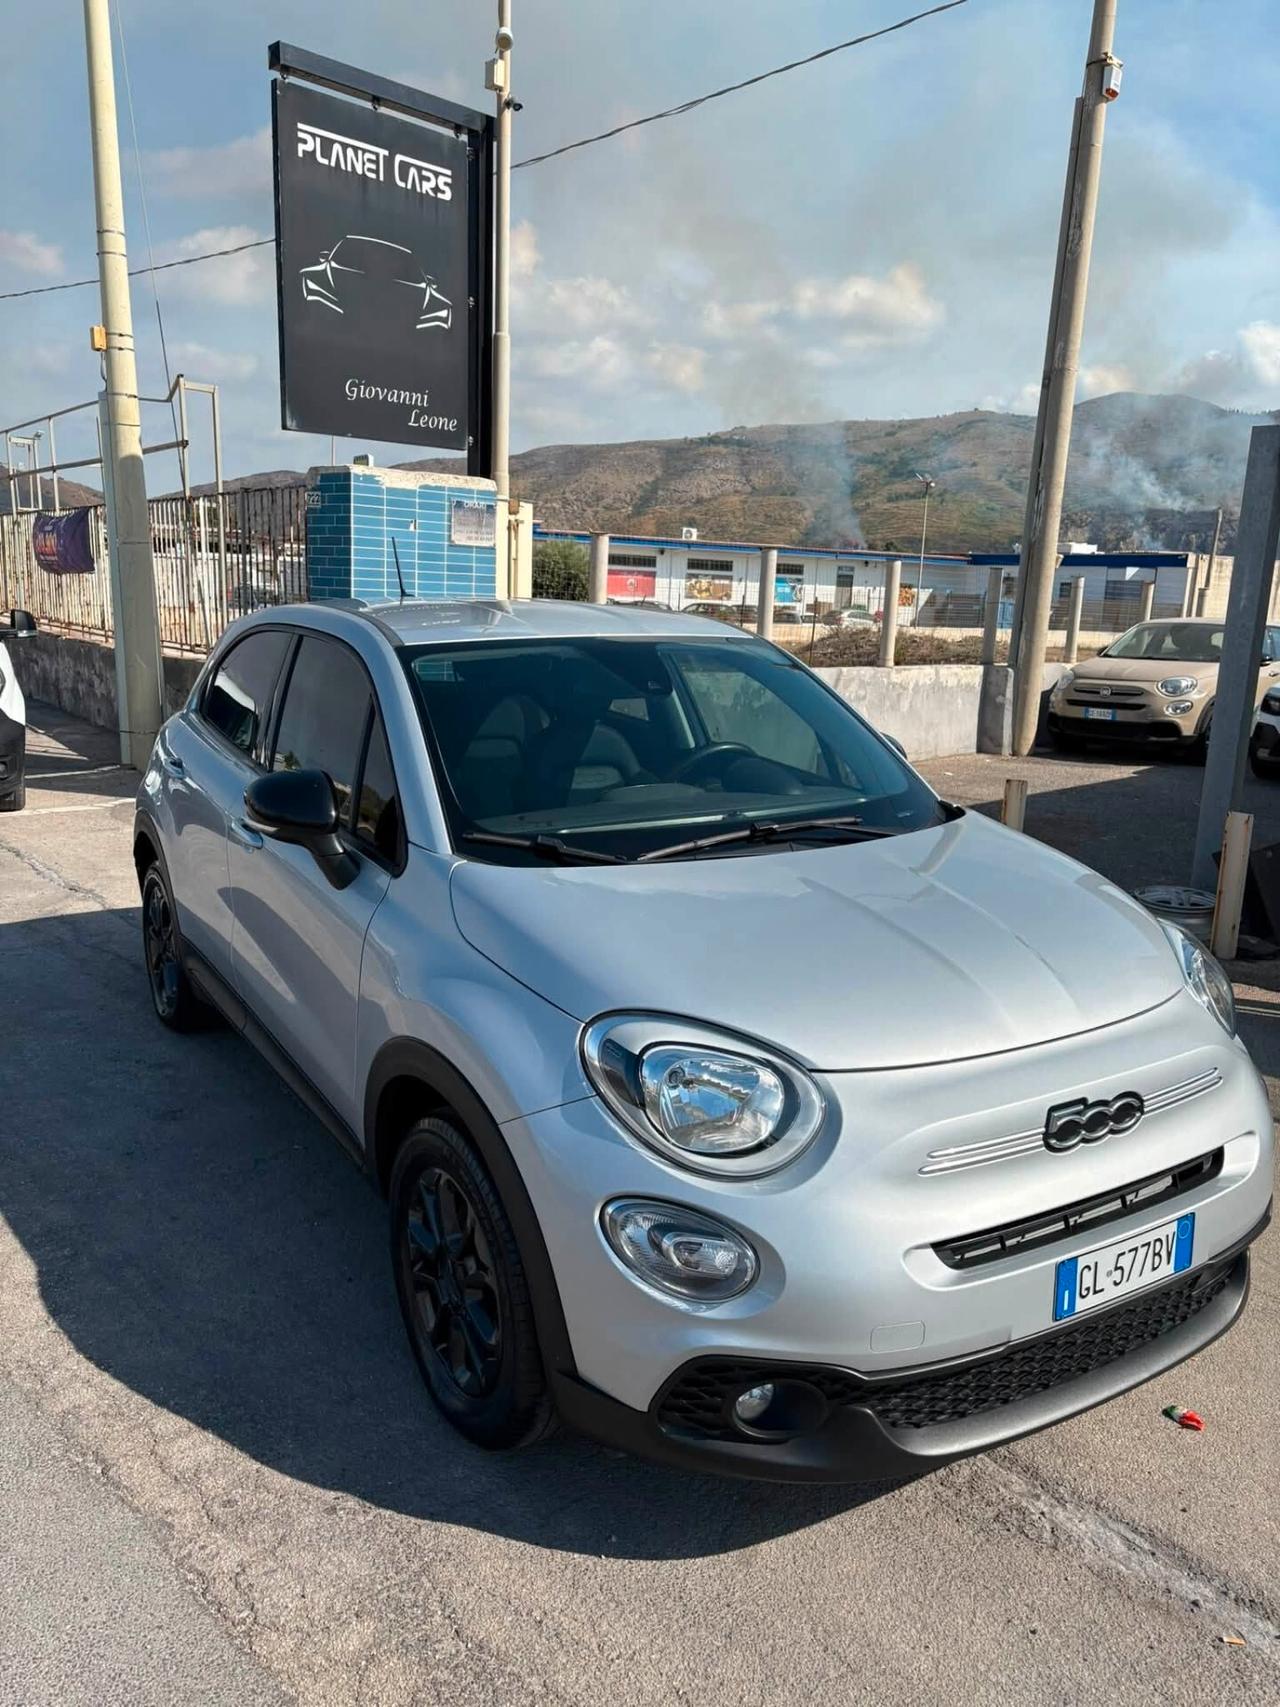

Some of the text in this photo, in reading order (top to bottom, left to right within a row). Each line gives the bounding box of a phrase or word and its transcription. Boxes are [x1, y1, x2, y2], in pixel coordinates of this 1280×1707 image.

[297, 122, 452, 201] PLANET CARS
[345, 378, 429, 407] Giovanni
[408, 410, 458, 432] Leone
[1043, 1091, 1144, 1153] 500
